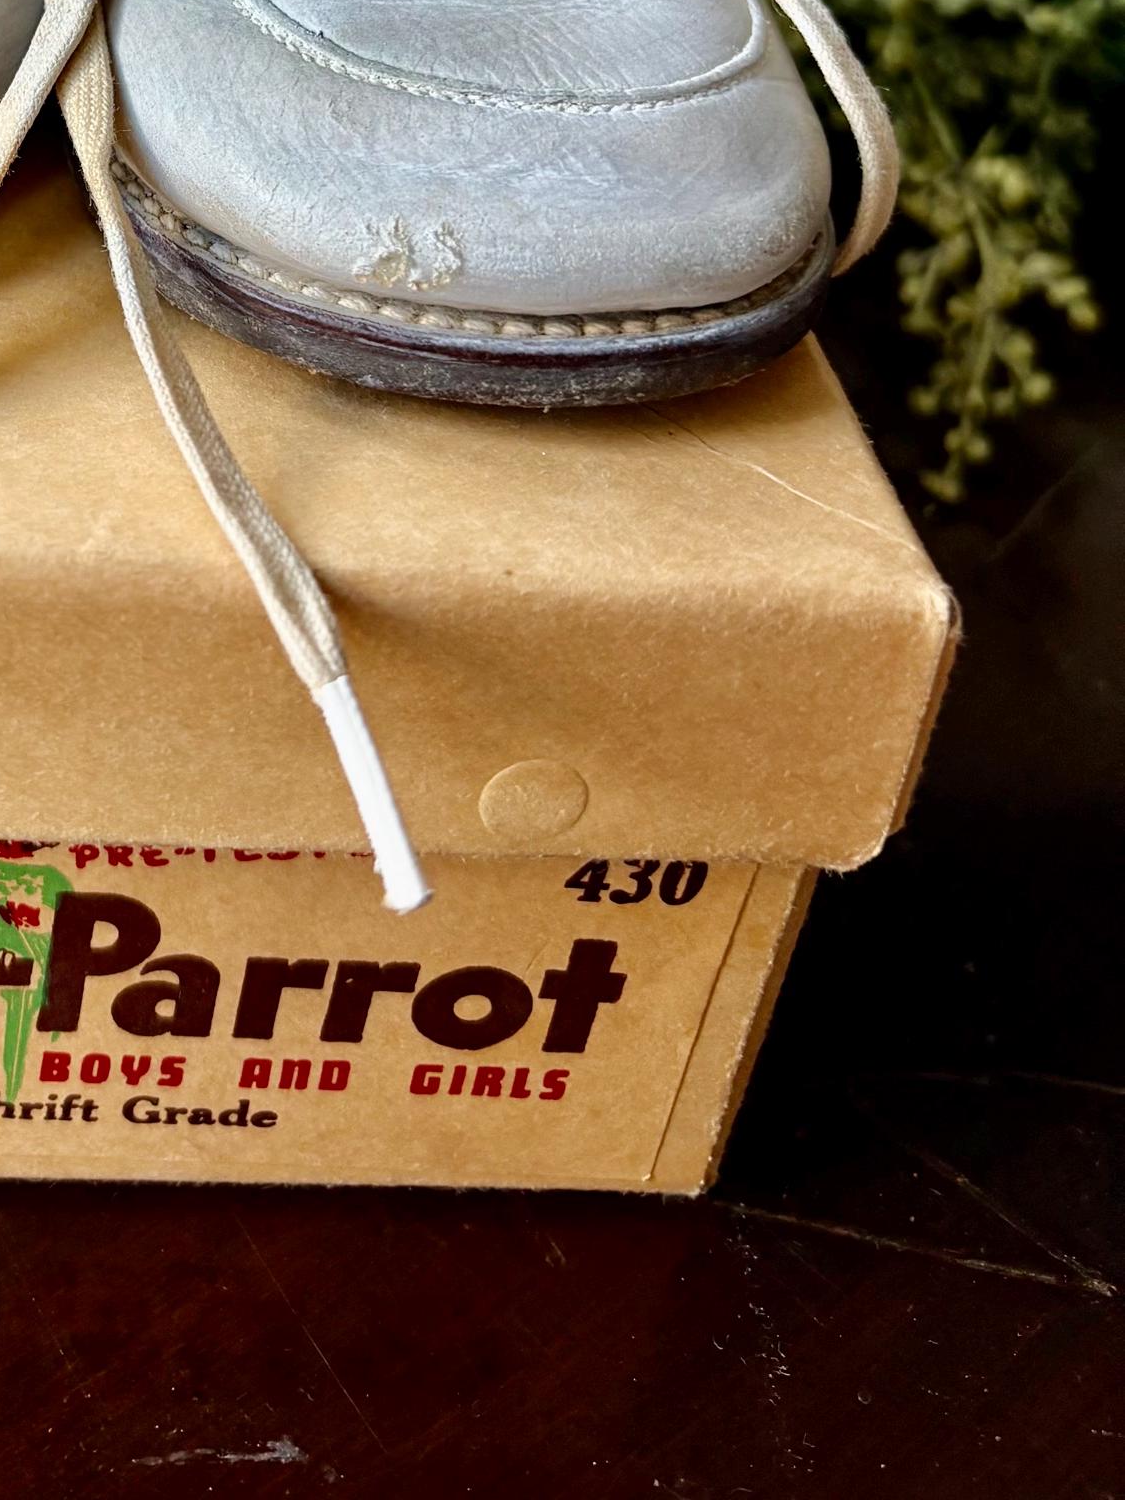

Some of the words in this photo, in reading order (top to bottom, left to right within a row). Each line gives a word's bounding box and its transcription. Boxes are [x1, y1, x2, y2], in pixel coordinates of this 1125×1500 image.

[563, 858, 710, 906] 430
[38, 1050, 188, 1088] BOYS
[238, 1057, 352, 1092] AND
[408, 1063, 572, 1101] GIRLS
[122, 1095, 279, 1129] Grade
